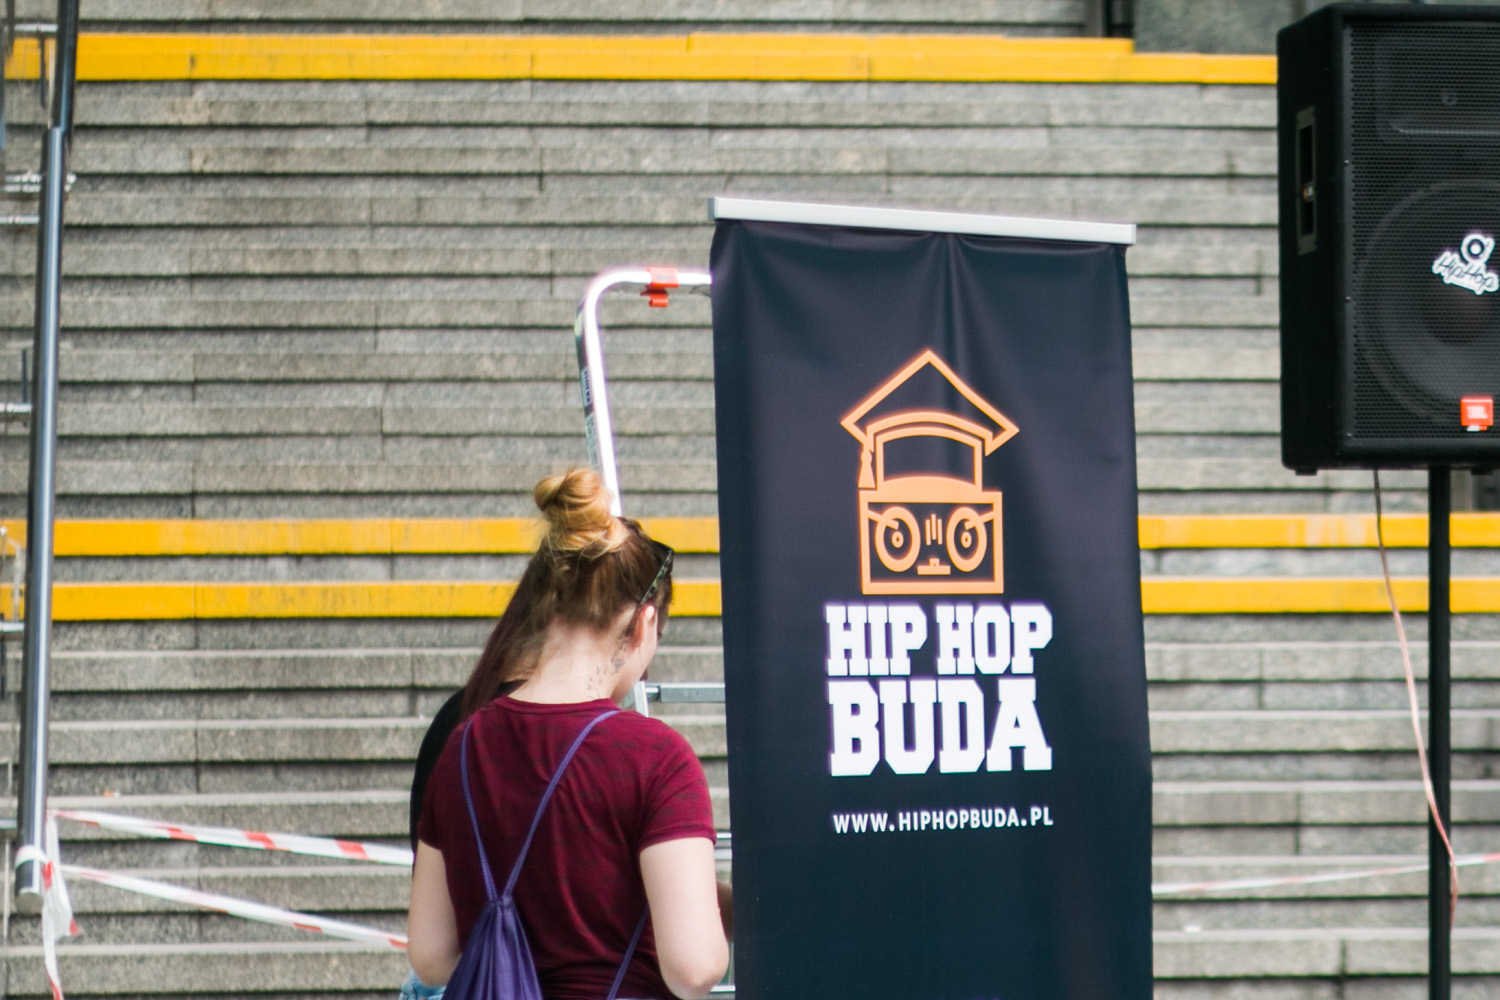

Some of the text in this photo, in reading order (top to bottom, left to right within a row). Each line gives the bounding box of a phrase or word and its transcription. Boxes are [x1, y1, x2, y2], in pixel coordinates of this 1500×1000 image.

[825, 602, 1053, 676] HIP HOP
[827, 678, 1053, 776] BUDA
[832, 805, 1054, 834] WWW.HIPHOPBUDA.PL
